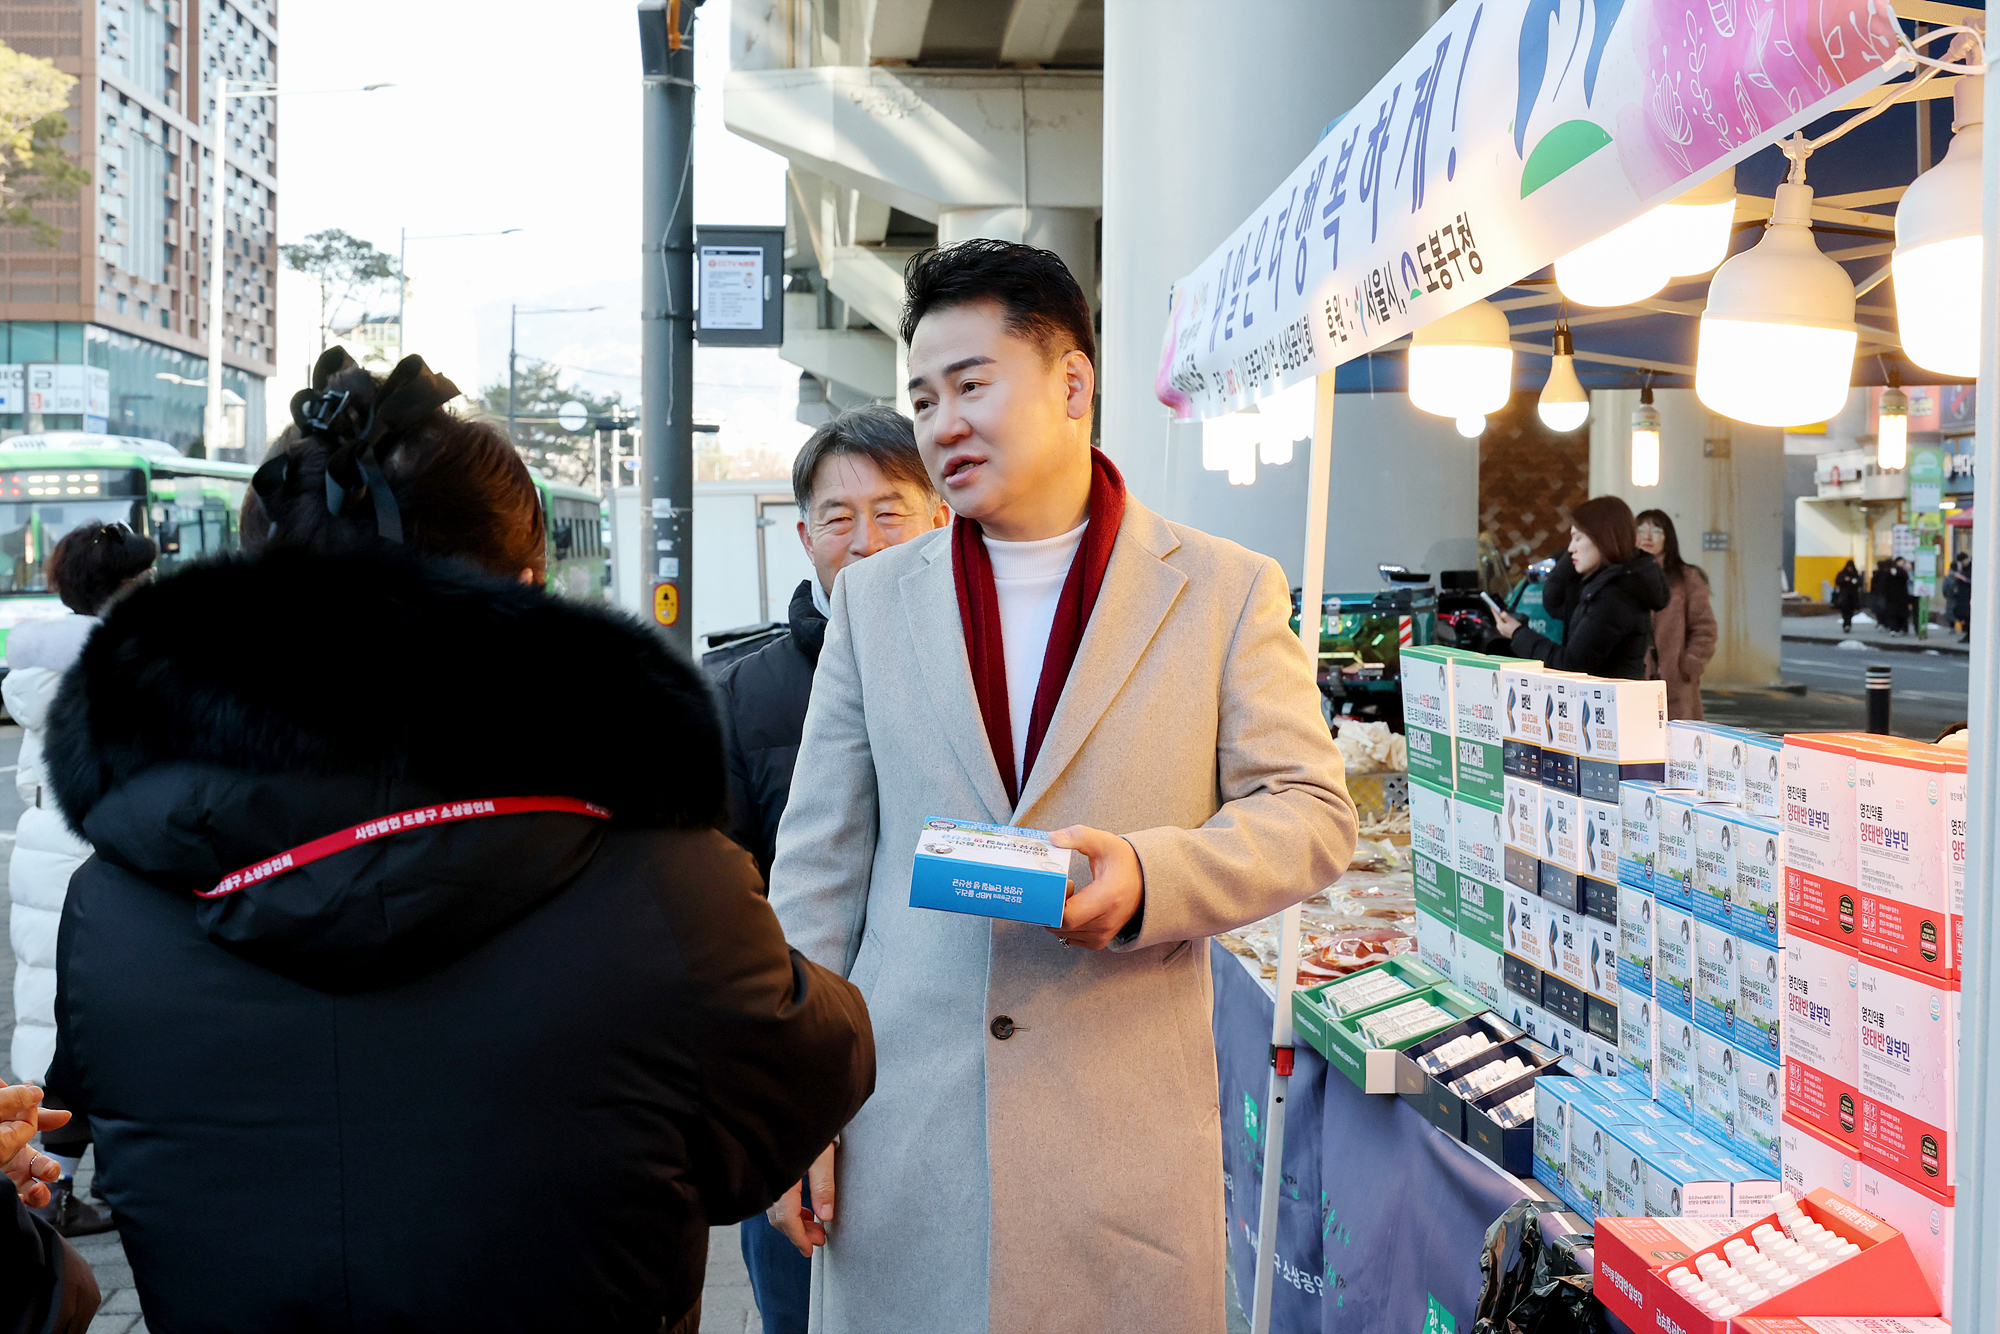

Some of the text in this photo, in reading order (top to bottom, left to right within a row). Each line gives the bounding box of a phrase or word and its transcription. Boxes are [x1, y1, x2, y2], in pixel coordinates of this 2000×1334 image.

[1416, 211, 1483, 294] 도봉구청
[1787, 784, 1807, 803] 영진약품
[355, 800, 496, 840] 사단법인 도봉구 소상공인회
[1787, 802, 1830, 831] 양태반 알부민
[1860, 803, 1883, 822] 영진약품
[1860, 822, 1909, 851] 양태반 알부민
[244, 853, 294, 884] 소상공인회
[952, 878, 1024, 896] 산양유 단백질 생 유산균
[954, 889, 975, 899] 플러스
[975, 891, 992, 900] MBP
[1788, 974, 1808, 995] 영진약품
[1788, 992, 1831, 1027] 양태반 알부민
[1861, 1006, 1885, 1028] 영진약품
[1862, 1025, 1910, 1063] 양태반 알부민
[1784, 1163, 1804, 1187] 영진약품
